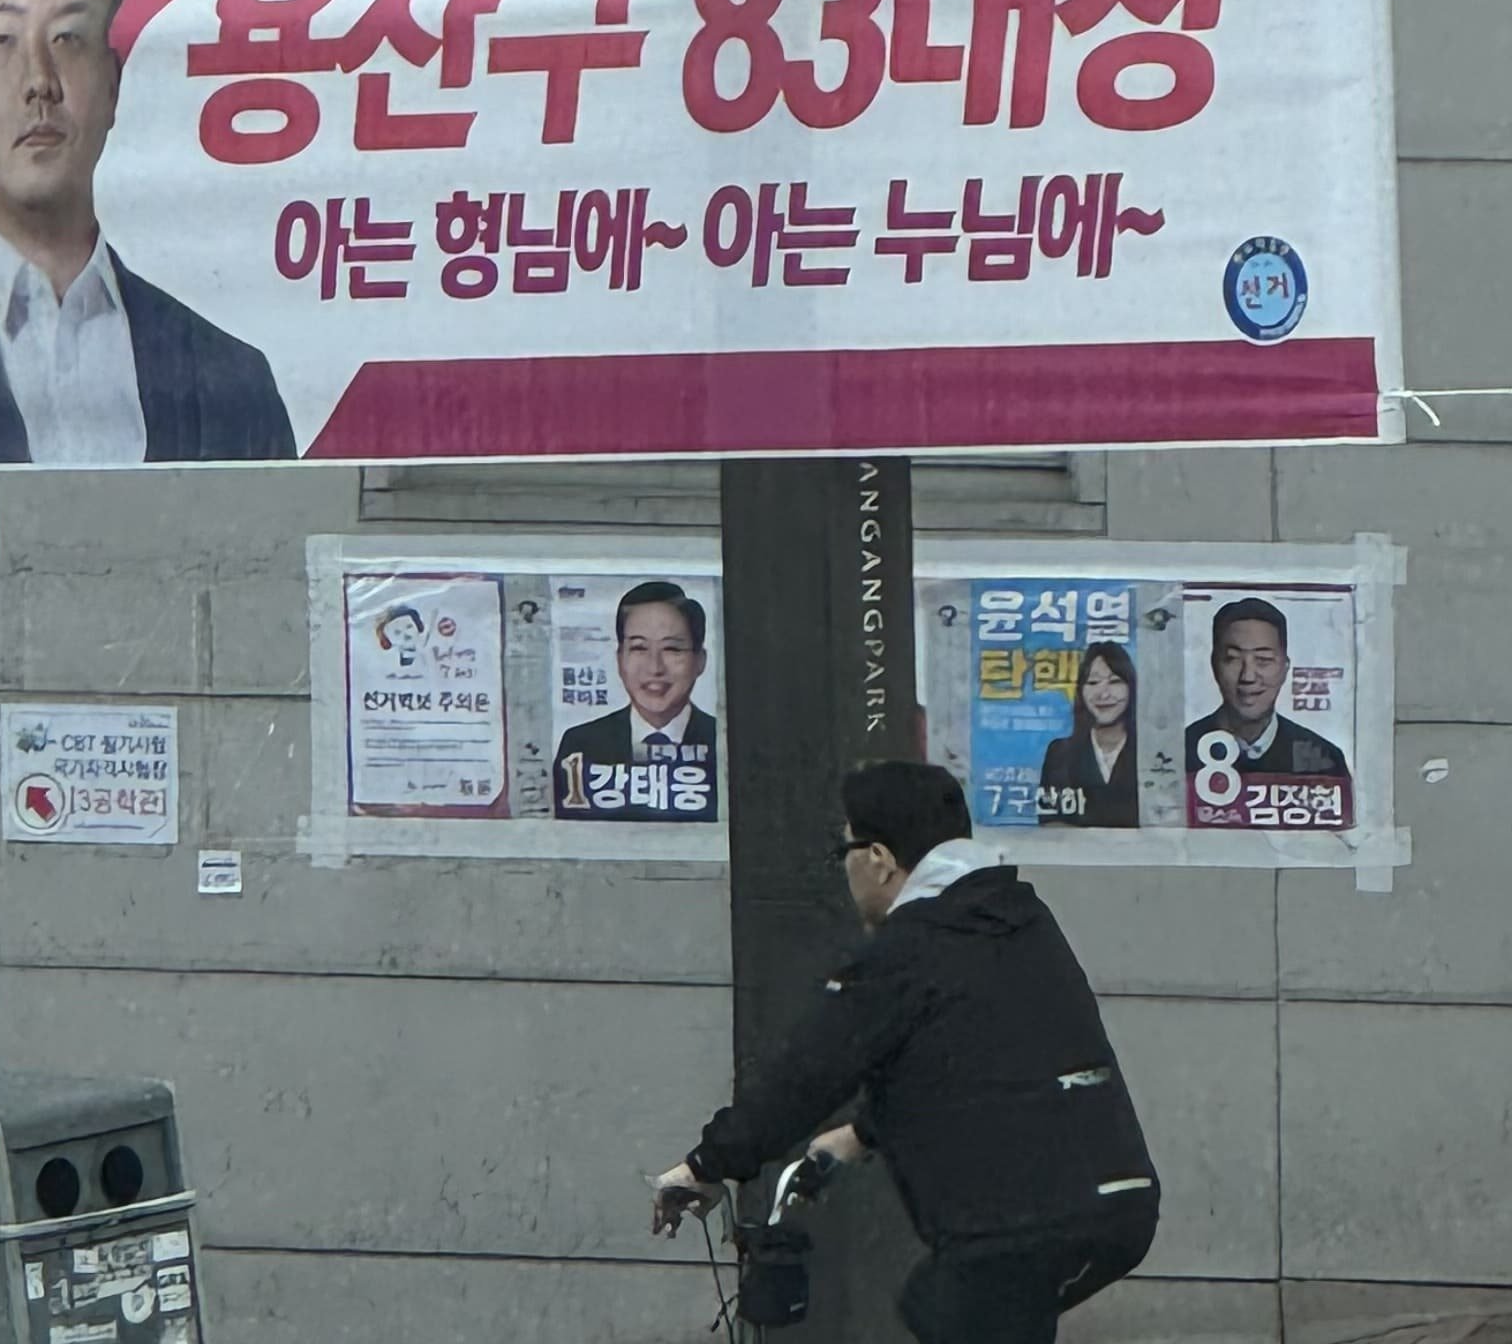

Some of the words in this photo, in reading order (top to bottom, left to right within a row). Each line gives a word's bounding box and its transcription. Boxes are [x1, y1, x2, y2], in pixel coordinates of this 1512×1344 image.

[274, 197, 415, 301] 아는
[434, 186, 688, 301] 형님에~
[702, 180, 861, 289] 아는
[873, 172, 1167, 286] 누님에~
[977, 590, 1130, 644] 윤석열
[561, 752, 590, 809] 1
[589, 763, 711, 812] 강태웅
[1195, 729, 1242, 806] 8
[1245, 784, 1344, 826] 김정현
